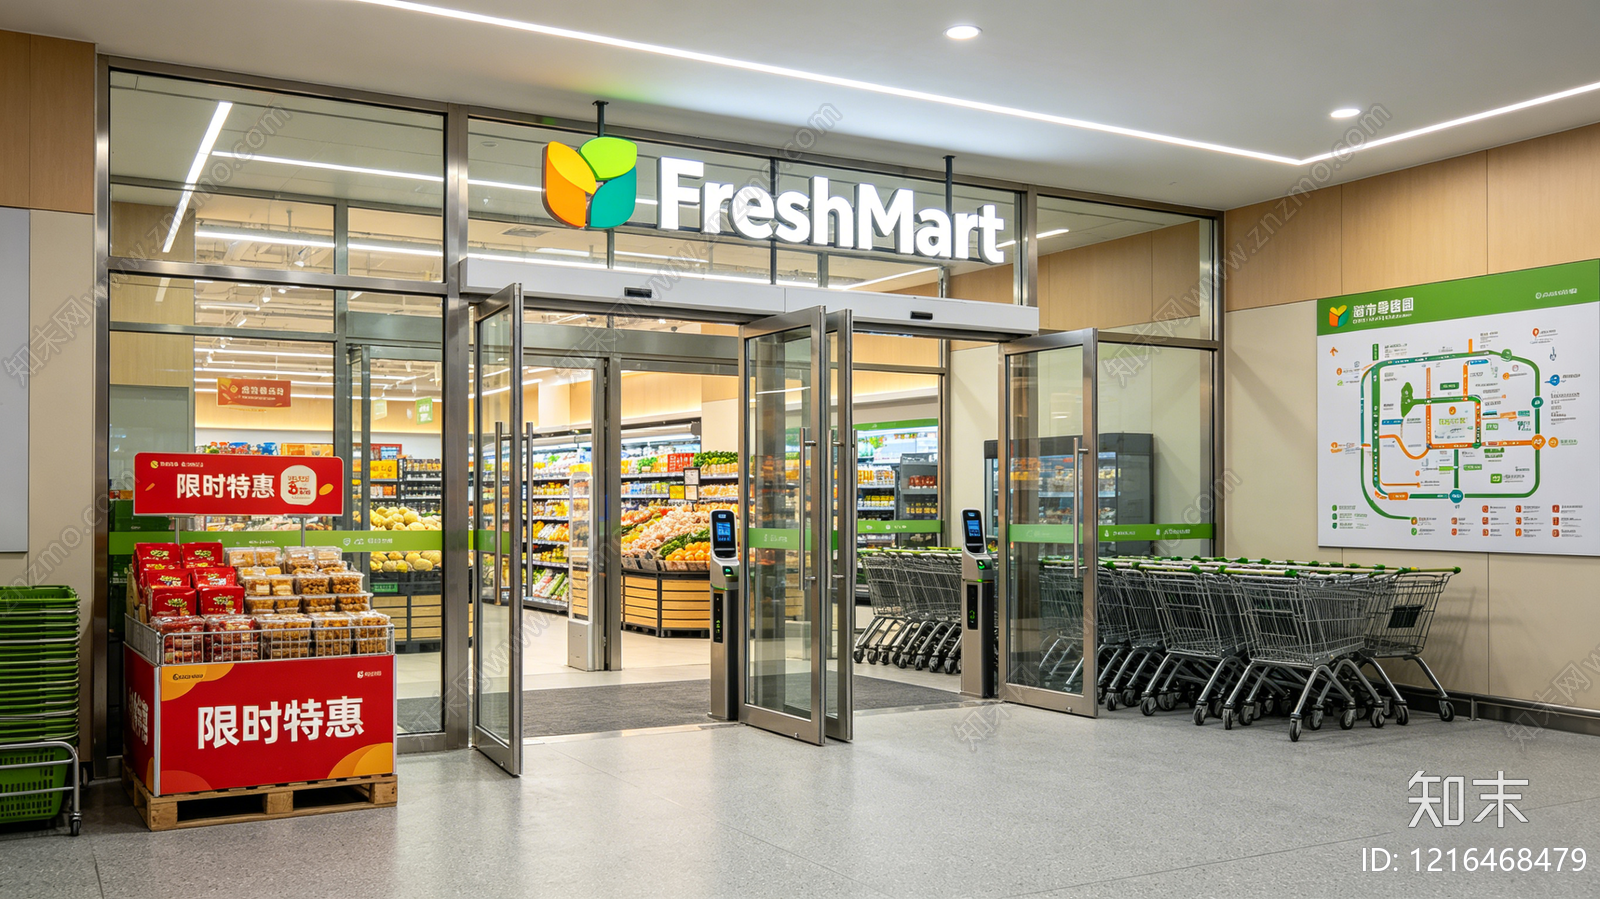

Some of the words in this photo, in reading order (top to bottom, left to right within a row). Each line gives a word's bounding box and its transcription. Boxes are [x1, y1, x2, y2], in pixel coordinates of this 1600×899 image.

[657, 156, 1005, 264] FreshMart
[177, 473, 275, 499] 限时特惠
[198, 696, 364, 750] 限时特惠
